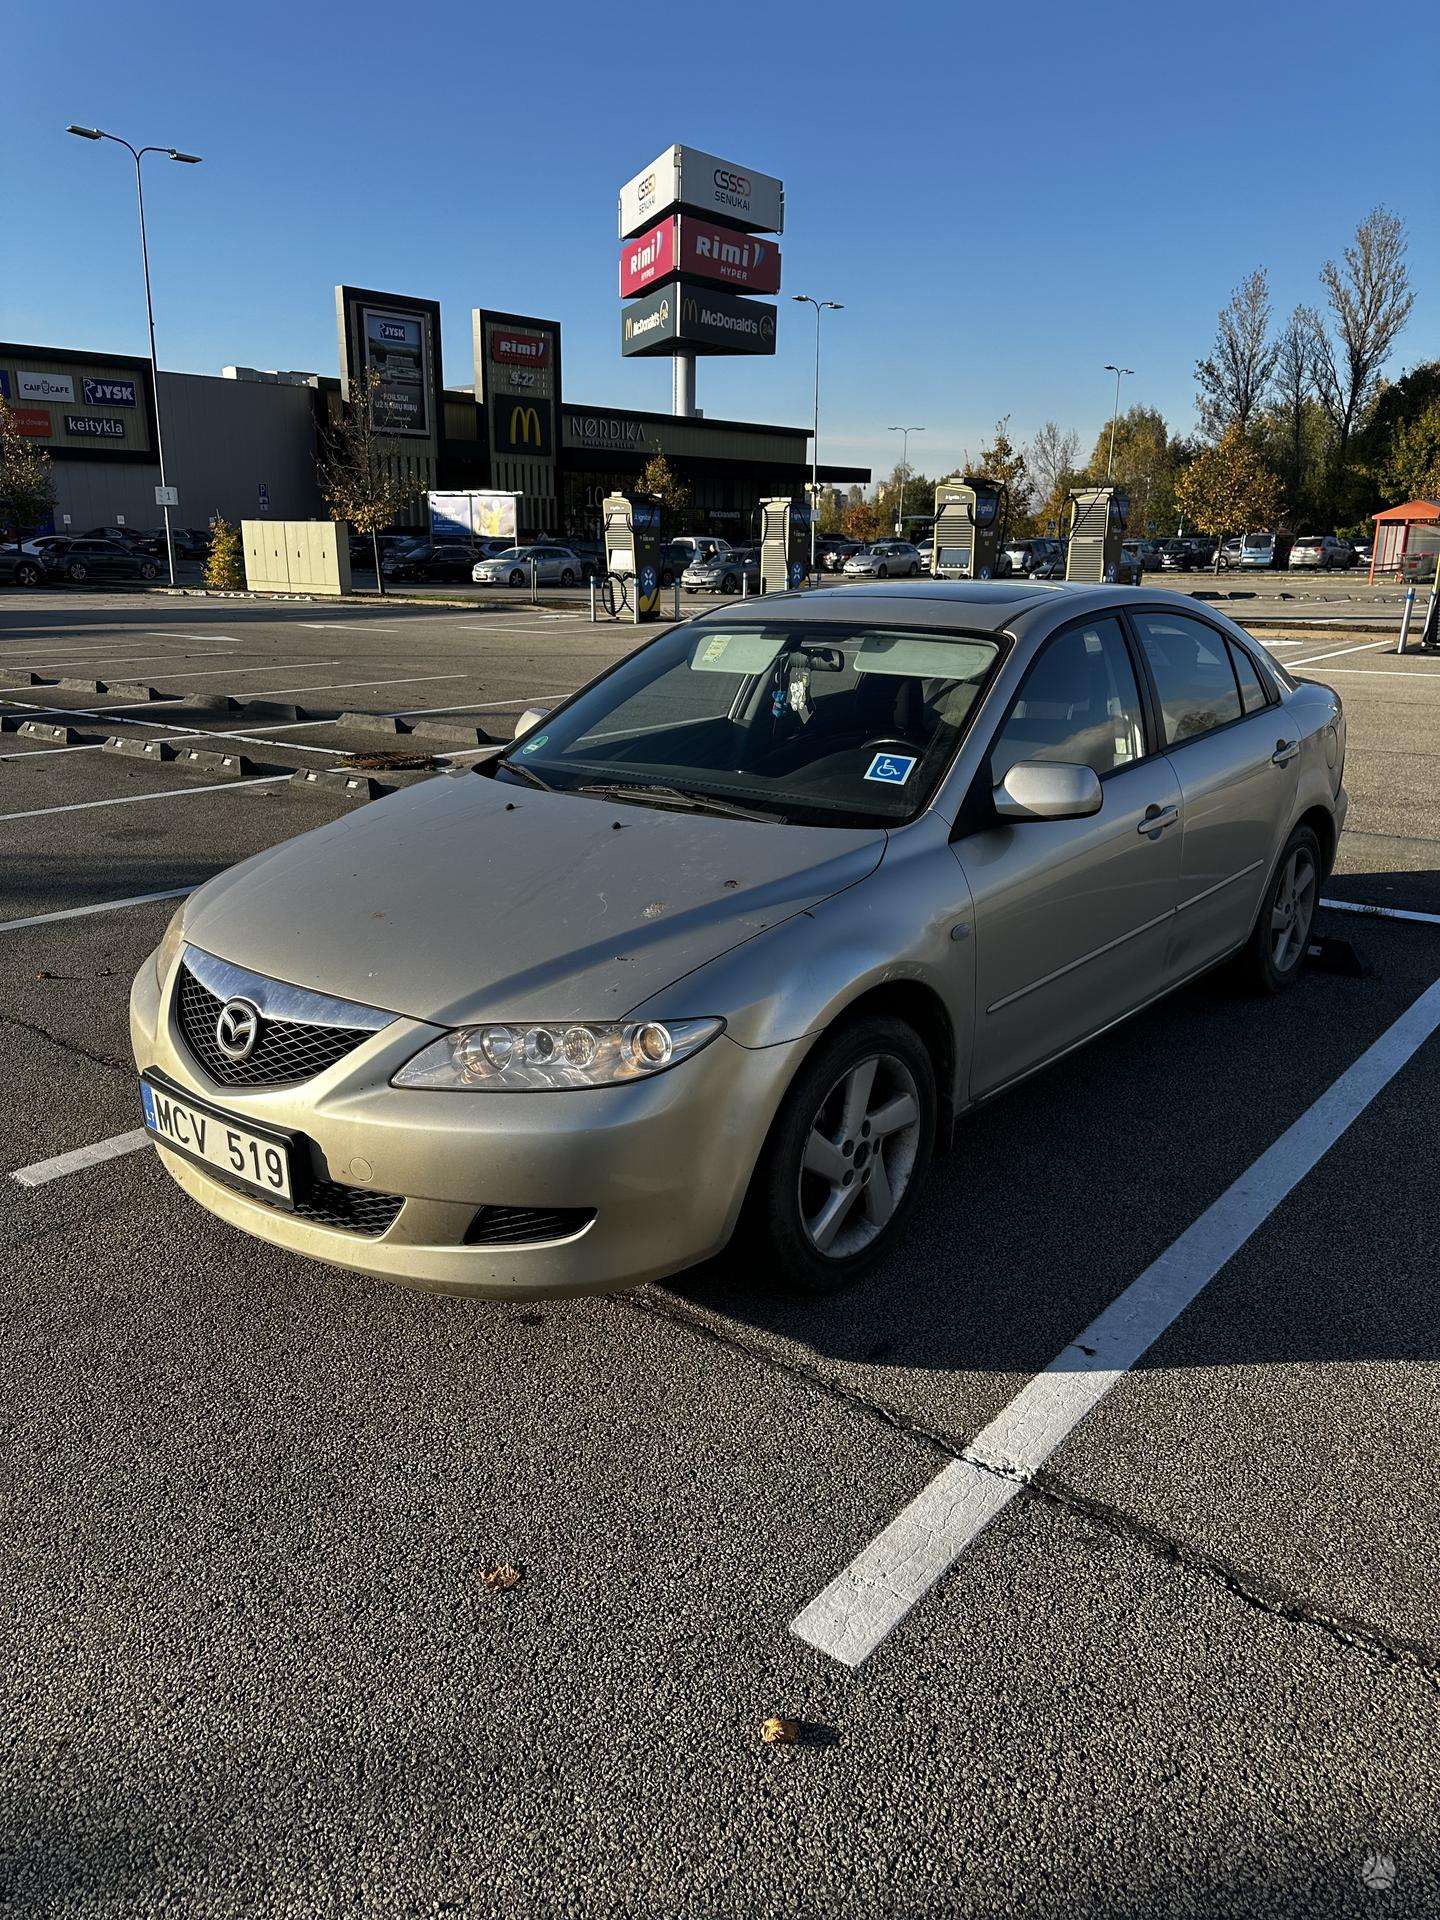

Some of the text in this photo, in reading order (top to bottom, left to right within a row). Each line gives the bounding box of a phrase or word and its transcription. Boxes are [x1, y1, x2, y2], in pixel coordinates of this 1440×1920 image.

[714, 192, 751, 211] SENUKAI
[630, 238, 656, 275] Rimi
[695, 235, 749, 267] Rimi
[720, 265, 748, 281] HYPER
[701, 309, 758, 334] McDonald's
[384, 326, 405, 338] JYSK
[500, 340, 537, 356] Rimi
[95, 385, 134, 401] JYSK
[68, 417, 123, 435] keitykla
[154, 1094, 284, 1189] MCV 519
